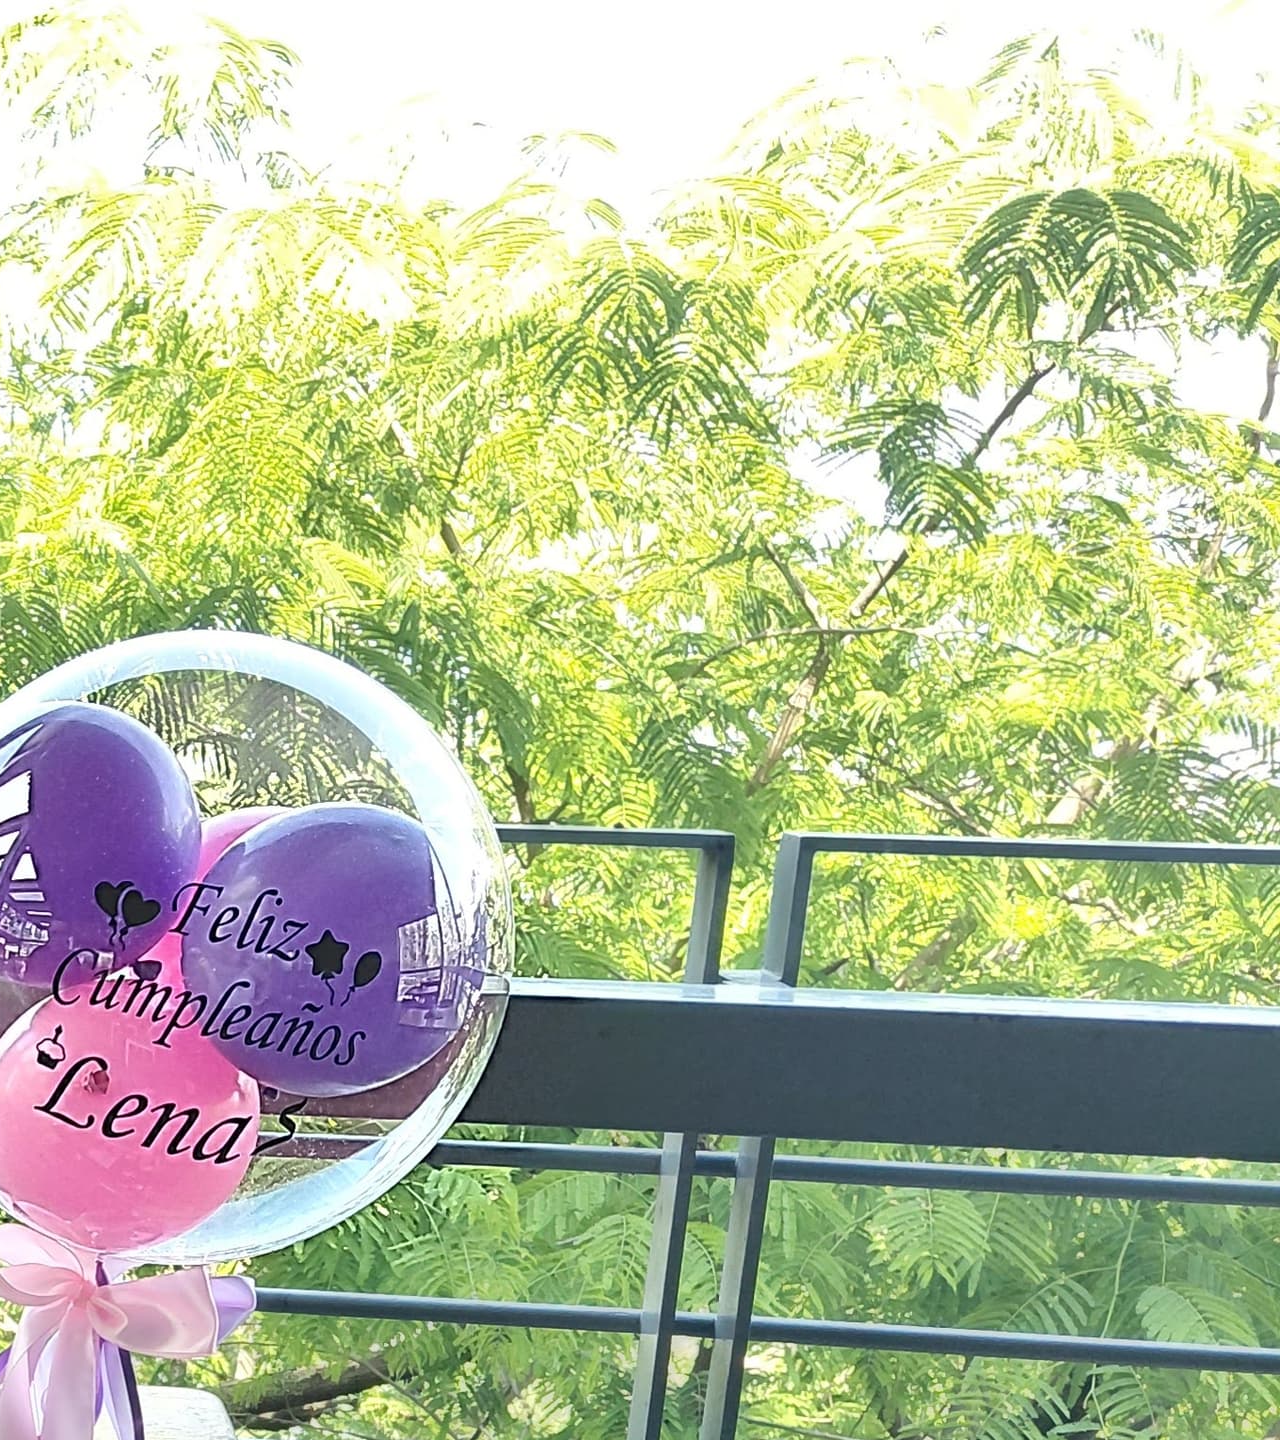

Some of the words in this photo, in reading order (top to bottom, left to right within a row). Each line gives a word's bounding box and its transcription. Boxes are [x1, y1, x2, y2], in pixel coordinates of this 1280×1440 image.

[171, 881, 308, 962] Feliz
[52, 949, 366, 1067] Cumpleaños
[35, 1056, 254, 1164] Lena
